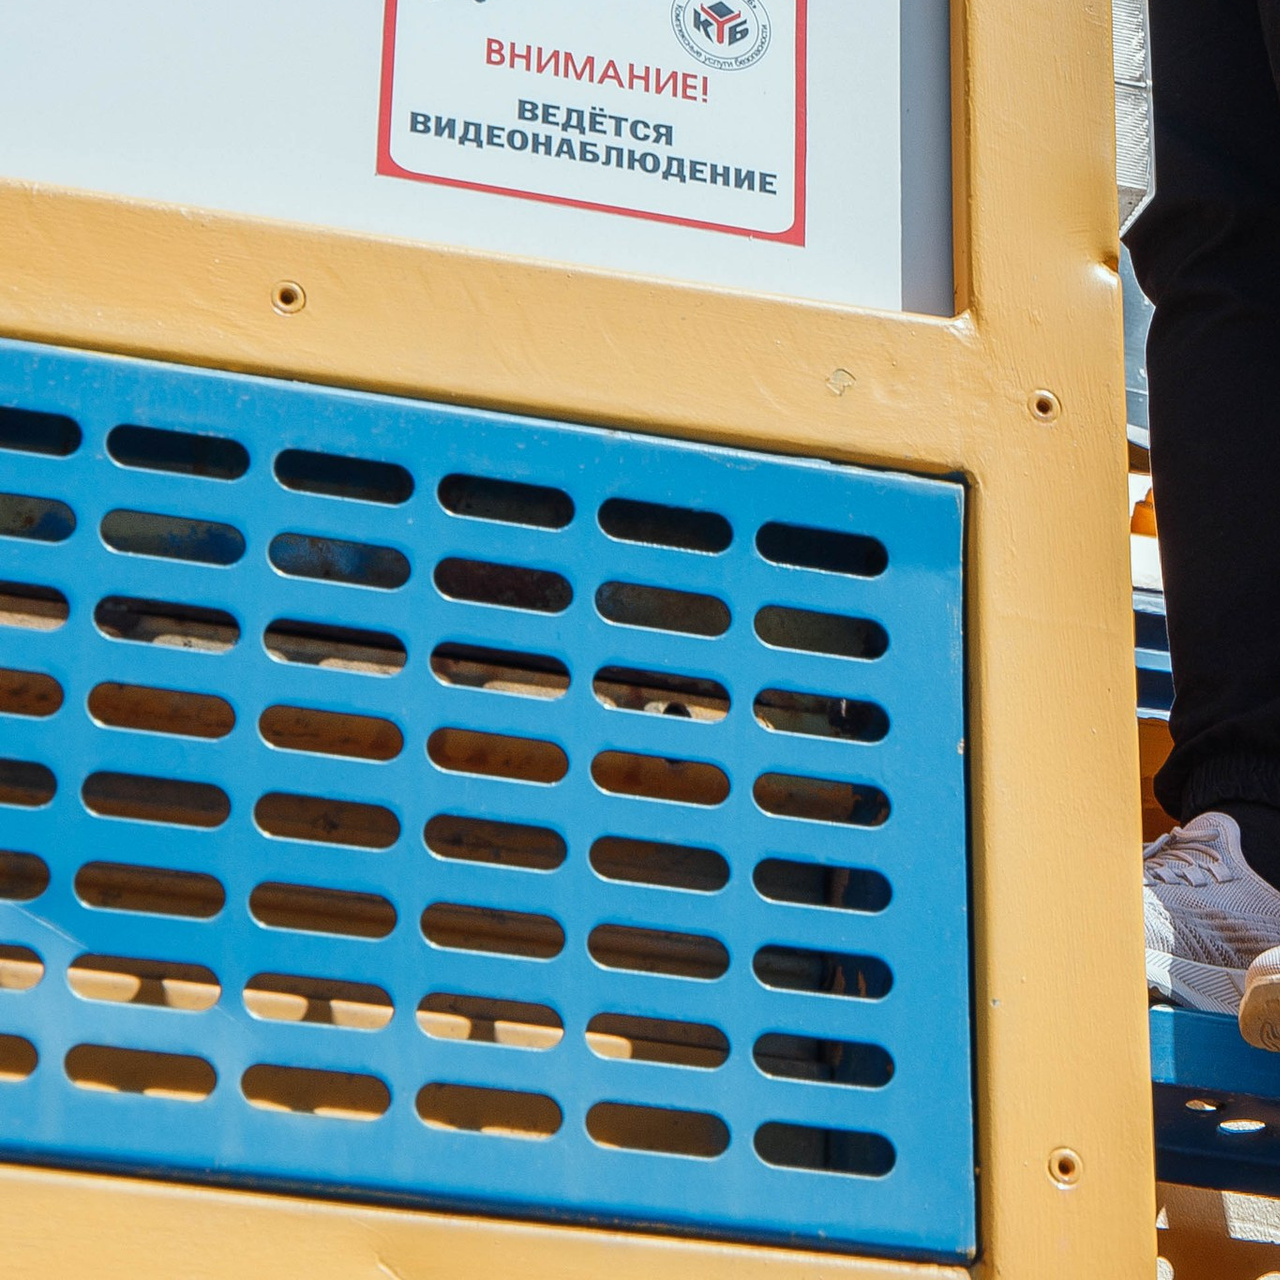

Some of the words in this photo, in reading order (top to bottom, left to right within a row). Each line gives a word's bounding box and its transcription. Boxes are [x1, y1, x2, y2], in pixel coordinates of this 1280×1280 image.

[485, 37, 709, 103] ВНИМАНИЕ!
[409, 111, 778, 196] ВИДЕОНАБЛЮДЕНИЕ
[517, 98, 674, 146] ВЕДЁТСЯ
